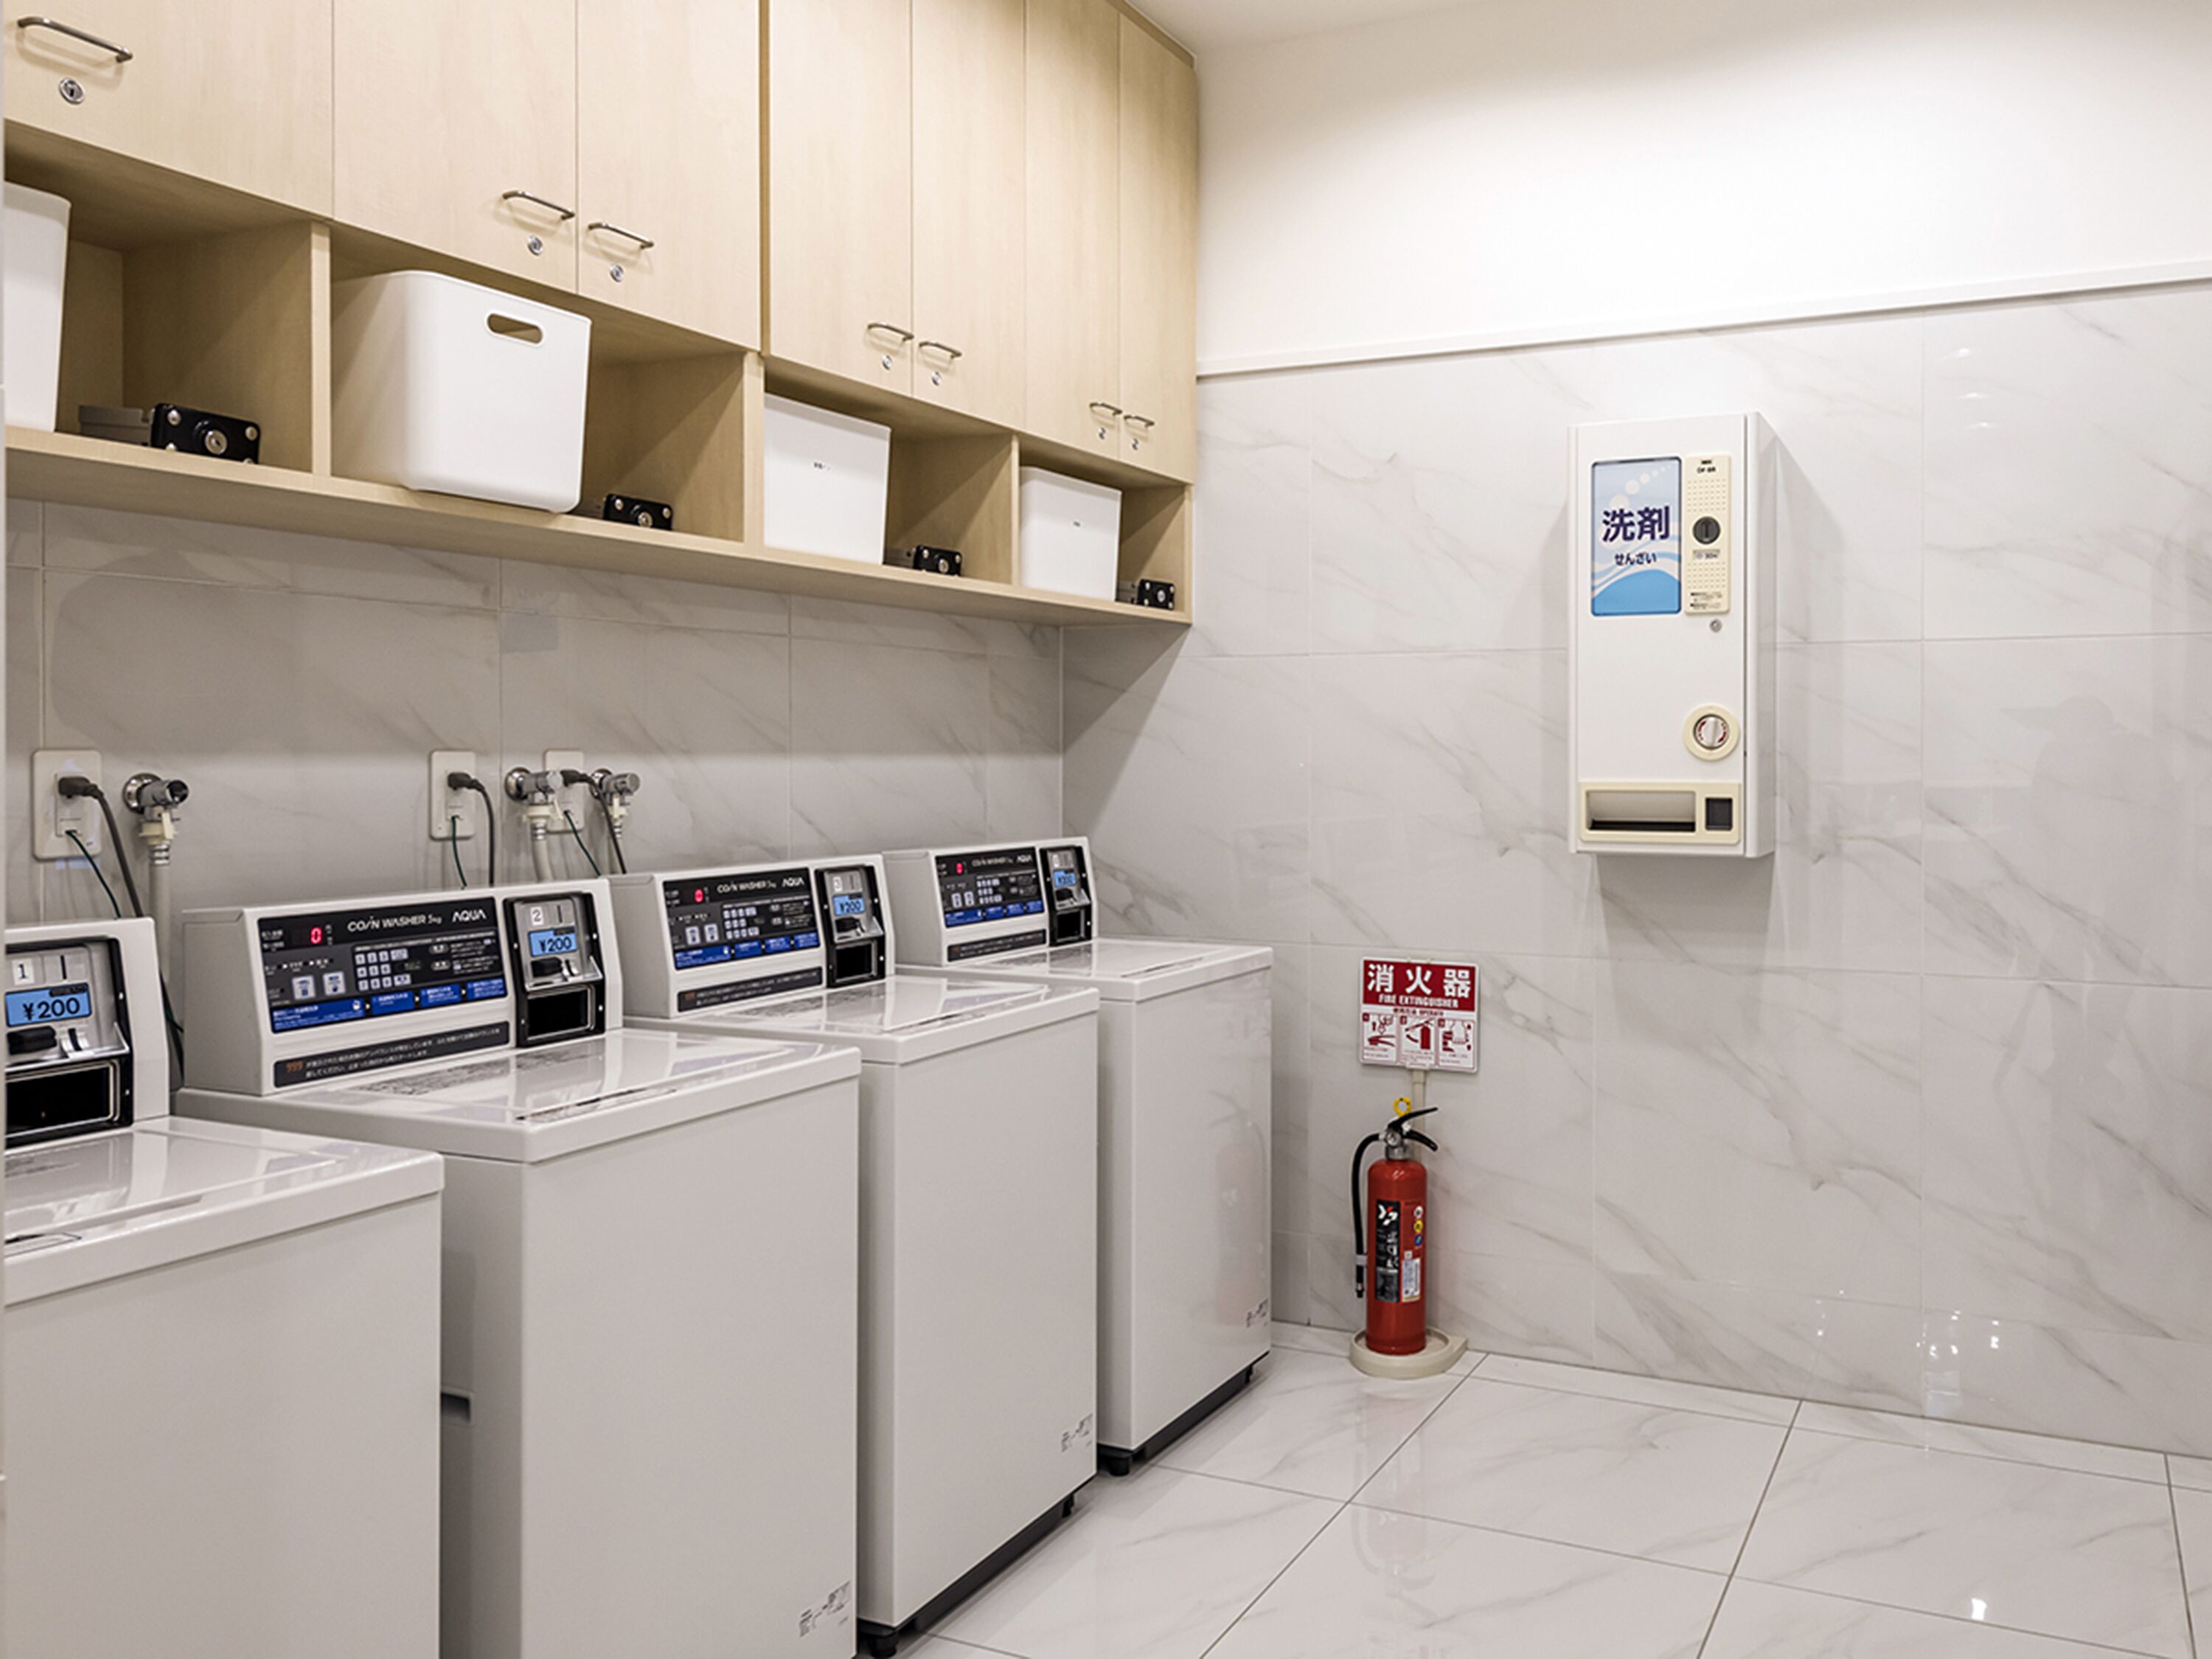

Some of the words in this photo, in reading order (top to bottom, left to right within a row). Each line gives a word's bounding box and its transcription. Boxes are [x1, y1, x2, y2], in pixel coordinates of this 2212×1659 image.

[1603, 506, 1669, 542] 洗剤
[1614, 552, 1657, 566] せんざい
[383, 914, 426, 928] WASHER
[452, 909, 487, 922] AQUA
[532, 909, 541, 922] 2
[310, 927, 322, 944] 0
[539, 936, 572, 952] ¥200
[18, 964, 27, 979] 1
[1368, 964, 1471, 998] 消火器
[23, 998, 80, 1020] ¥200
